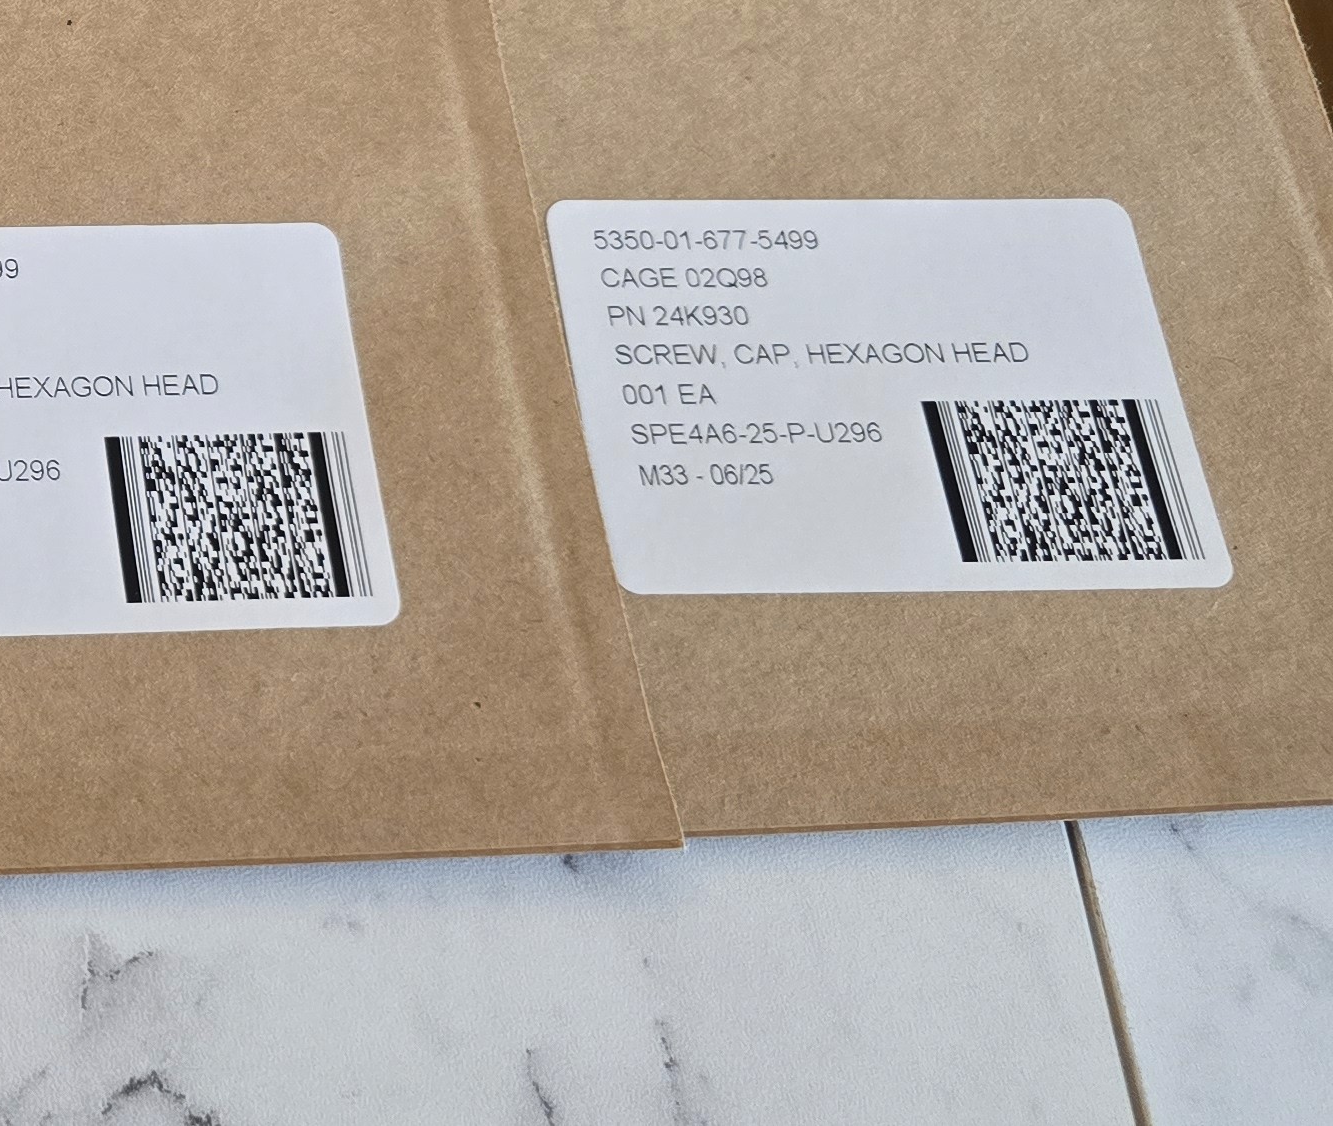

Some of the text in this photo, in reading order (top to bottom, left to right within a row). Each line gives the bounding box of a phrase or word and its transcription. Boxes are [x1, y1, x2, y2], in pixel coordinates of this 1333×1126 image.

[593, 229, 819, 251] 5350-01-677-5499
[600, 267, 769, 289] CAGE 02Q98
[606, 305, 750, 327] PN 24K930
[614, 341, 1029, 368] SCREW, CAP, HEXAGON HEAD
[141, 373, 219, 397] HEAD
[622, 383, 717, 406] 001 EA
[630, 421, 883, 445] SPE4A6-25-P-U296
[638, 463, 775, 487] M33 06/25
